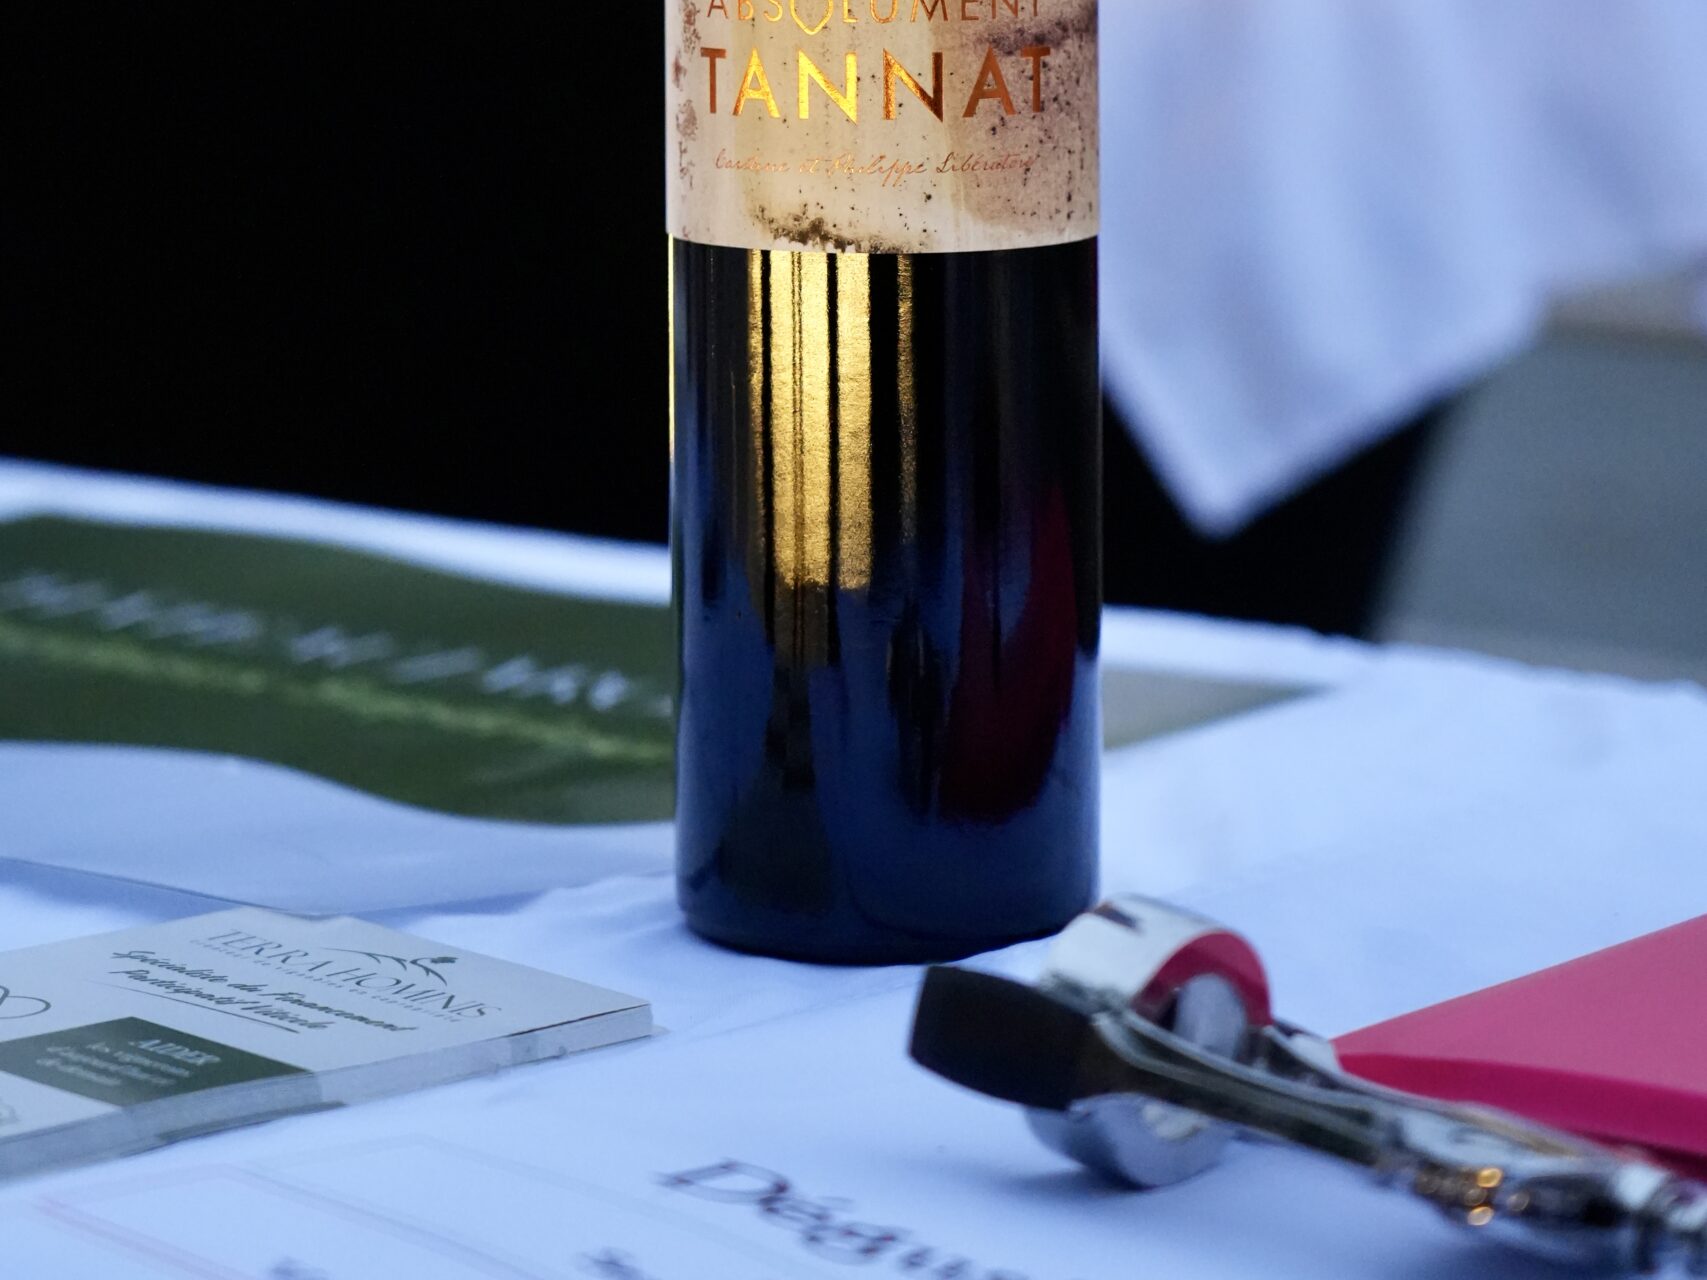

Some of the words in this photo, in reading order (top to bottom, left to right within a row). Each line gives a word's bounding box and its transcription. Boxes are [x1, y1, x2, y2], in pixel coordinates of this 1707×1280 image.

[700, 46, 1051, 124] TANNAT
[826, 152, 927, 189] Philippe
[109, 950, 229, 983] Spécialiste
[226, 981, 269, 993] du
[206, 928, 335, 972] TERRA
[325, 967, 502, 1019] HOMINIS
